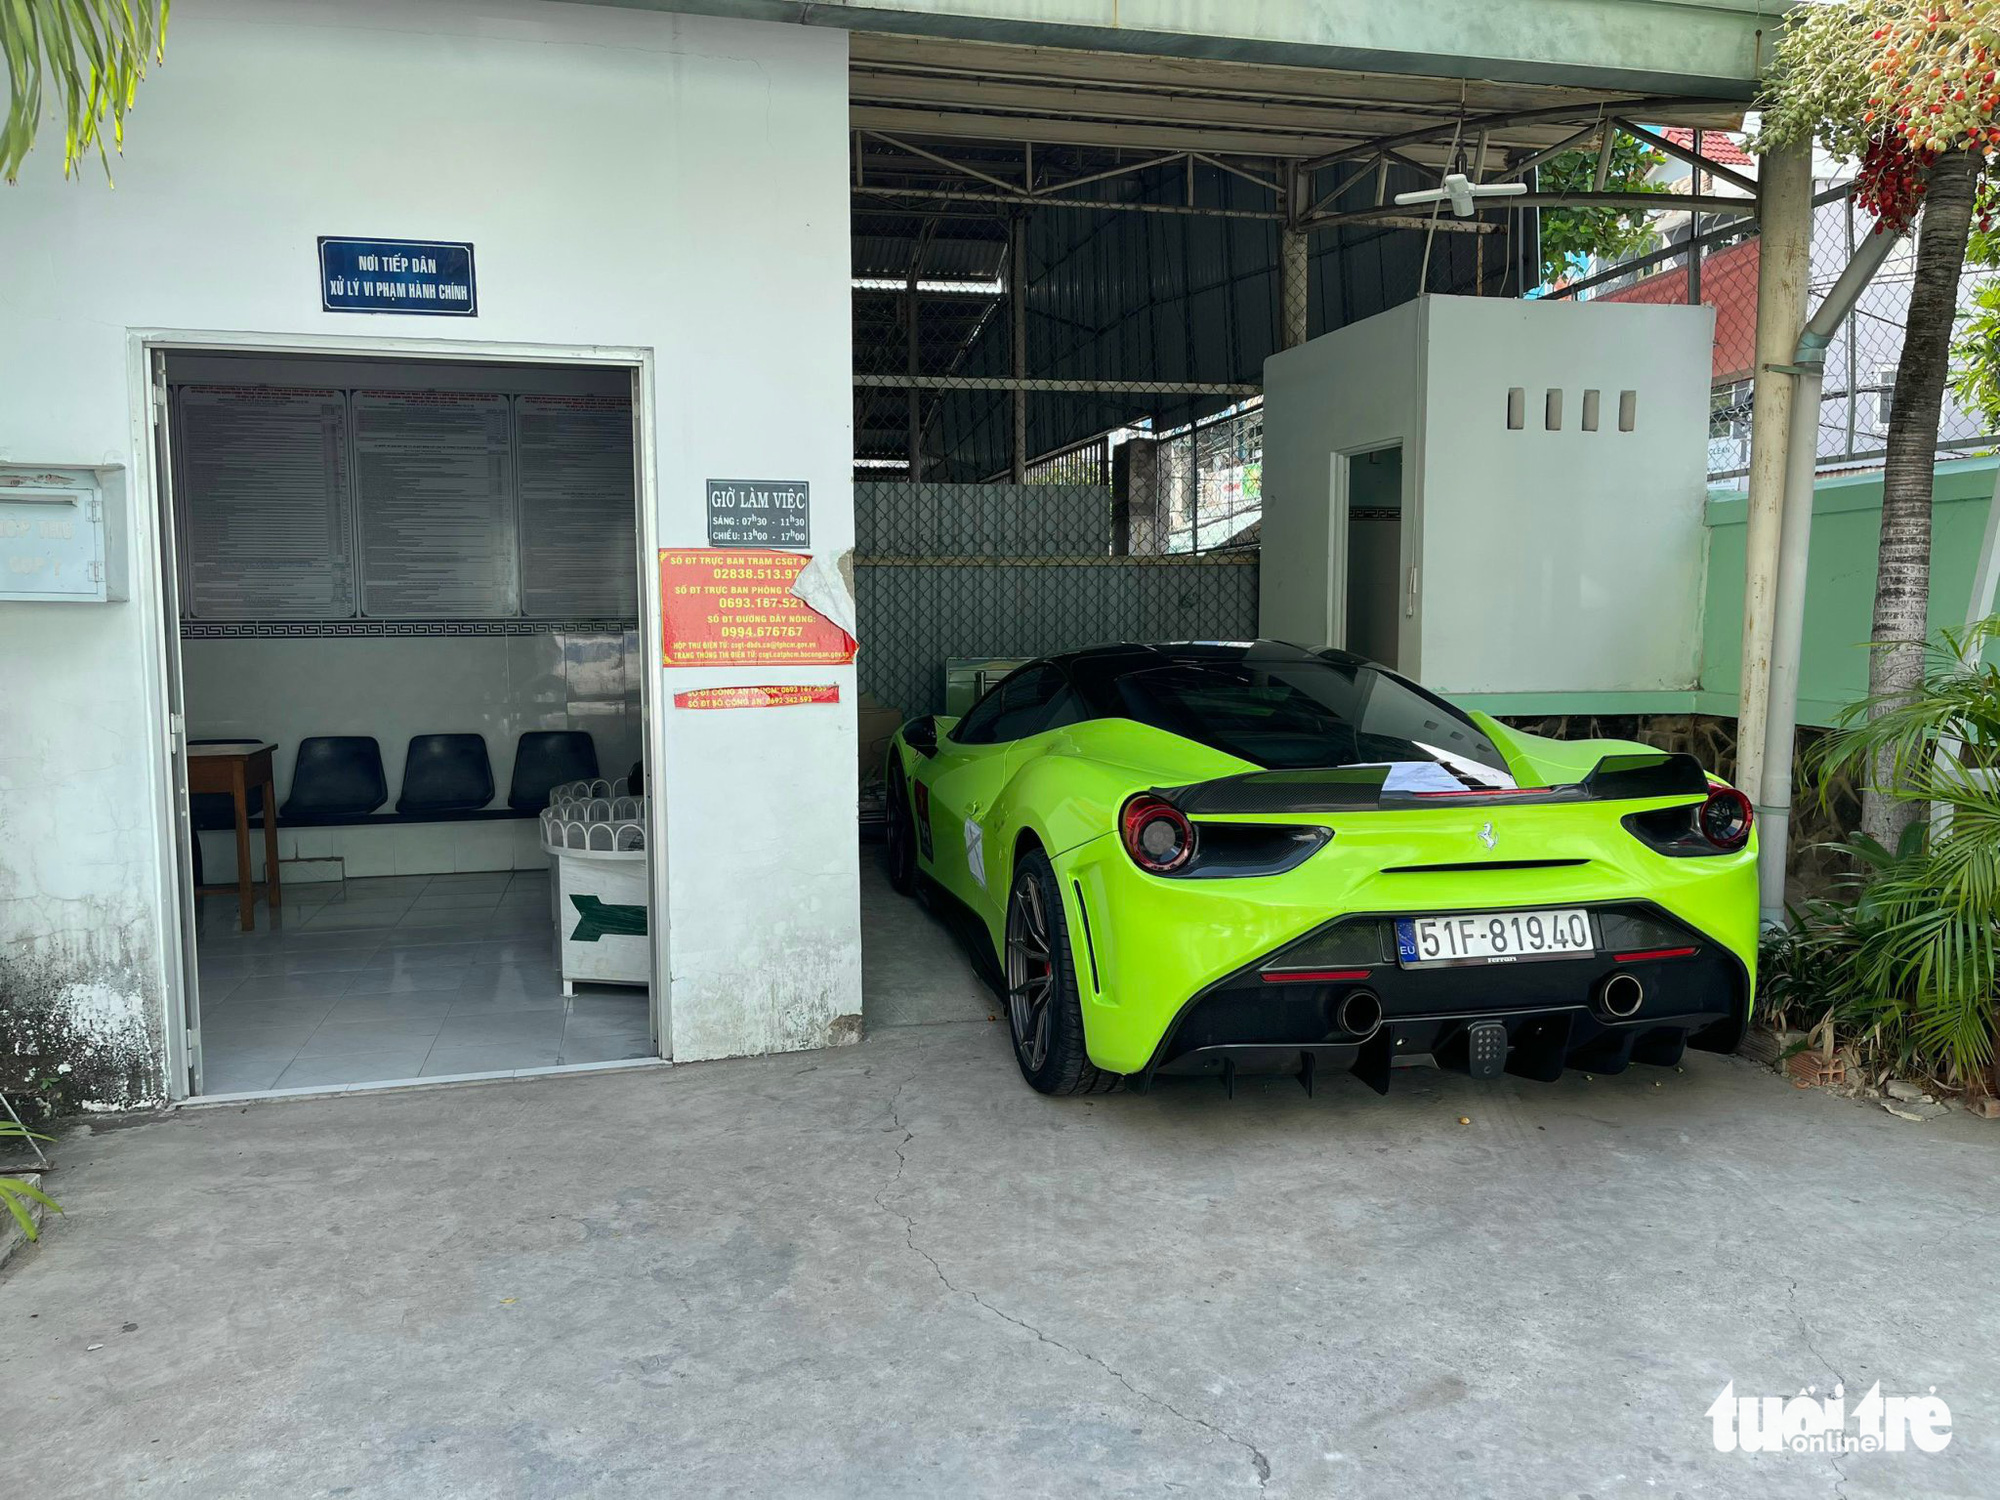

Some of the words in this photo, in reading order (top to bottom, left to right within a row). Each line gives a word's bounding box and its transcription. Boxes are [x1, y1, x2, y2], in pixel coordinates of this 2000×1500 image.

[358, 254, 379, 272] NƠI
[382, 253, 408, 273] TIẾP
[412, 255, 437, 274] DÂN
[330, 275, 344, 296] XỬ
[347, 276, 359, 297] LÝ
[363, 281, 374, 297] VI
[376, 281, 406, 301] PHẠM
[409, 280, 436, 299] HÀNH
[438, 282, 468, 301] CHÍNH
[711, 486, 735, 508] GIỜ
[740, 487, 769, 509] LÀM
[772, 488, 805, 513] VIỆC
[685, 557, 697, 565] ĐT
[726, 557, 745, 565] BAN
[775, 557, 798, 566] CSGT
[713, 568, 800, 579] 02838.513.97
[690, 586, 701, 594] ĐT
[731, 586, 749, 594] BAN
[722, 615, 733, 623] ĐT
[721, 626, 803, 637] 0994.676767
[1420, 914, 1587, 957] 51F-819.40
[1400, 946, 1415, 955] EU
